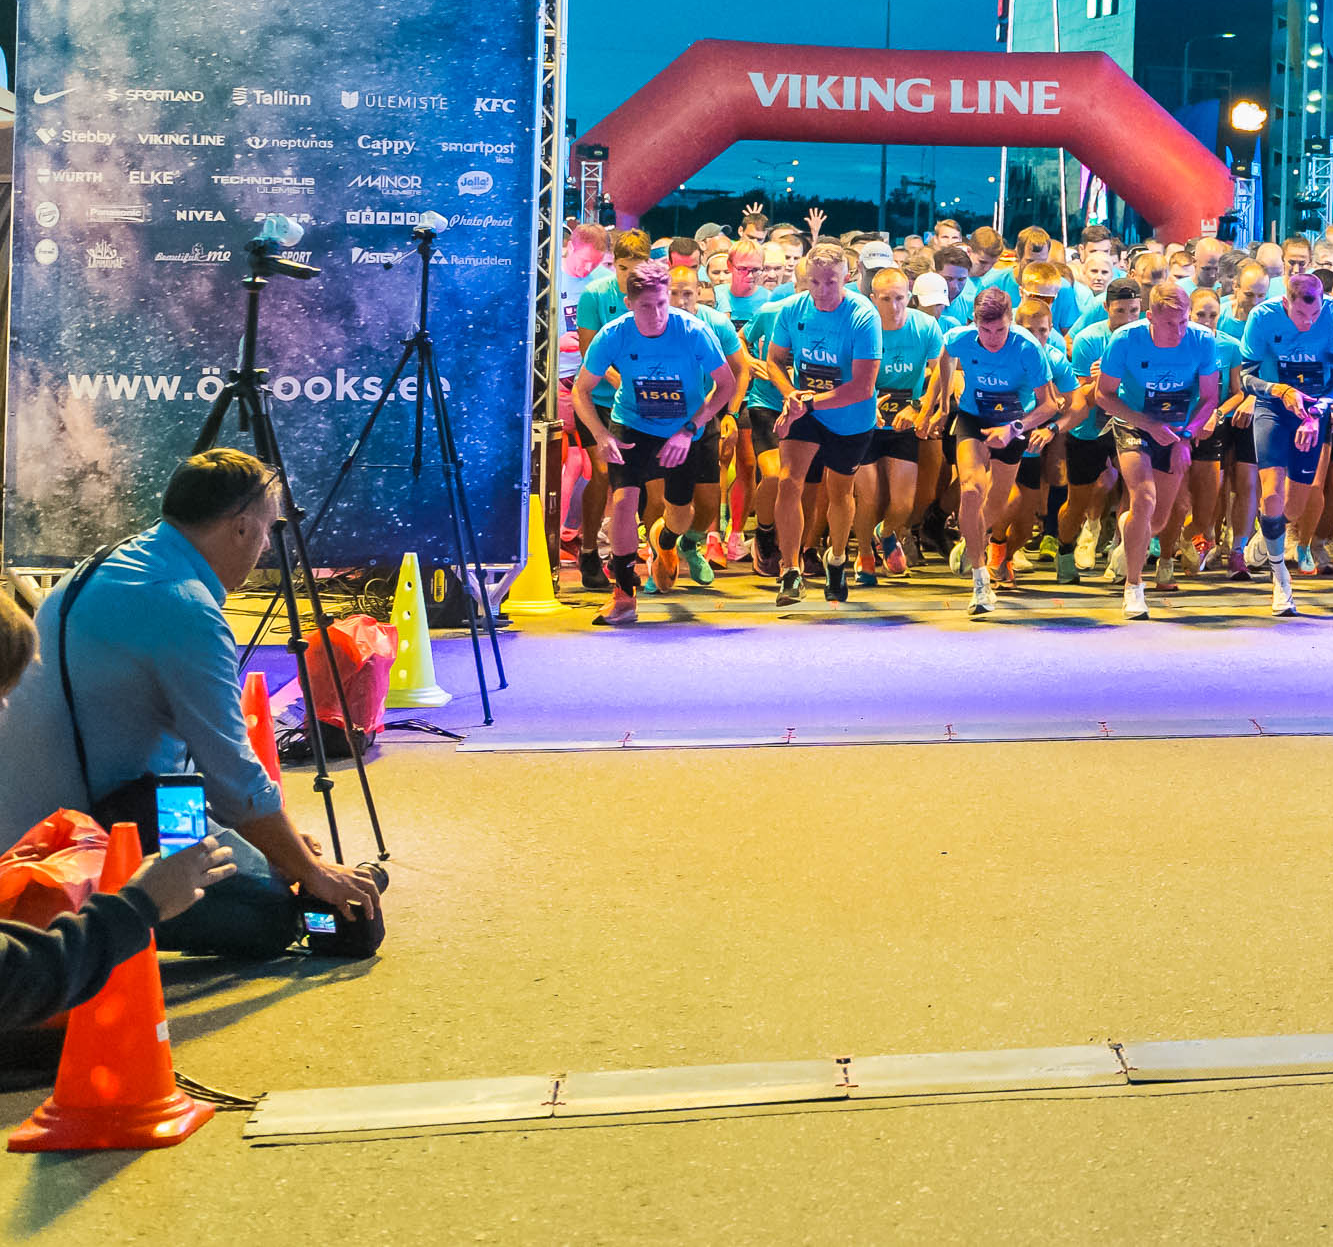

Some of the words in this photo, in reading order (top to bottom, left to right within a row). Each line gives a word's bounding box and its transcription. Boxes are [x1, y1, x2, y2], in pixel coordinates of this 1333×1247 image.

[125, 89, 204, 102] SPORTLAND
[253, 90, 311, 106] Tallinn
[748, 72, 935, 113] VIKING
[950, 79, 1061, 115] LINE
[365, 93, 448, 110] ÜLEMISTE
[474, 98, 516, 113] KFC
[61, 130, 116, 146] Stebby
[138, 133, 190, 145] VIKING
[193, 135, 225, 146] LINE
[358, 135, 416, 155] Cappy
[441, 141, 515, 156] smartpost
[129, 170, 174, 185] ELKE
[211, 175, 315, 186] TECHNOPOLIS
[348, 174, 422, 188] MAINOR
[176, 210, 226, 222] NIVEA
[348, 212, 421, 224] CRAMO
[450, 254, 512, 266] Ramudden
[802, 347, 837, 364] RUN
[885, 362, 914, 374] RUN
[68, 367, 451, 402] www.öooks.ee
[806, 377, 834, 390] 225
[640, 390, 681, 401] 1510
[994, 403, 1004, 412] 4
[1161, 402, 1172, 411] 2
